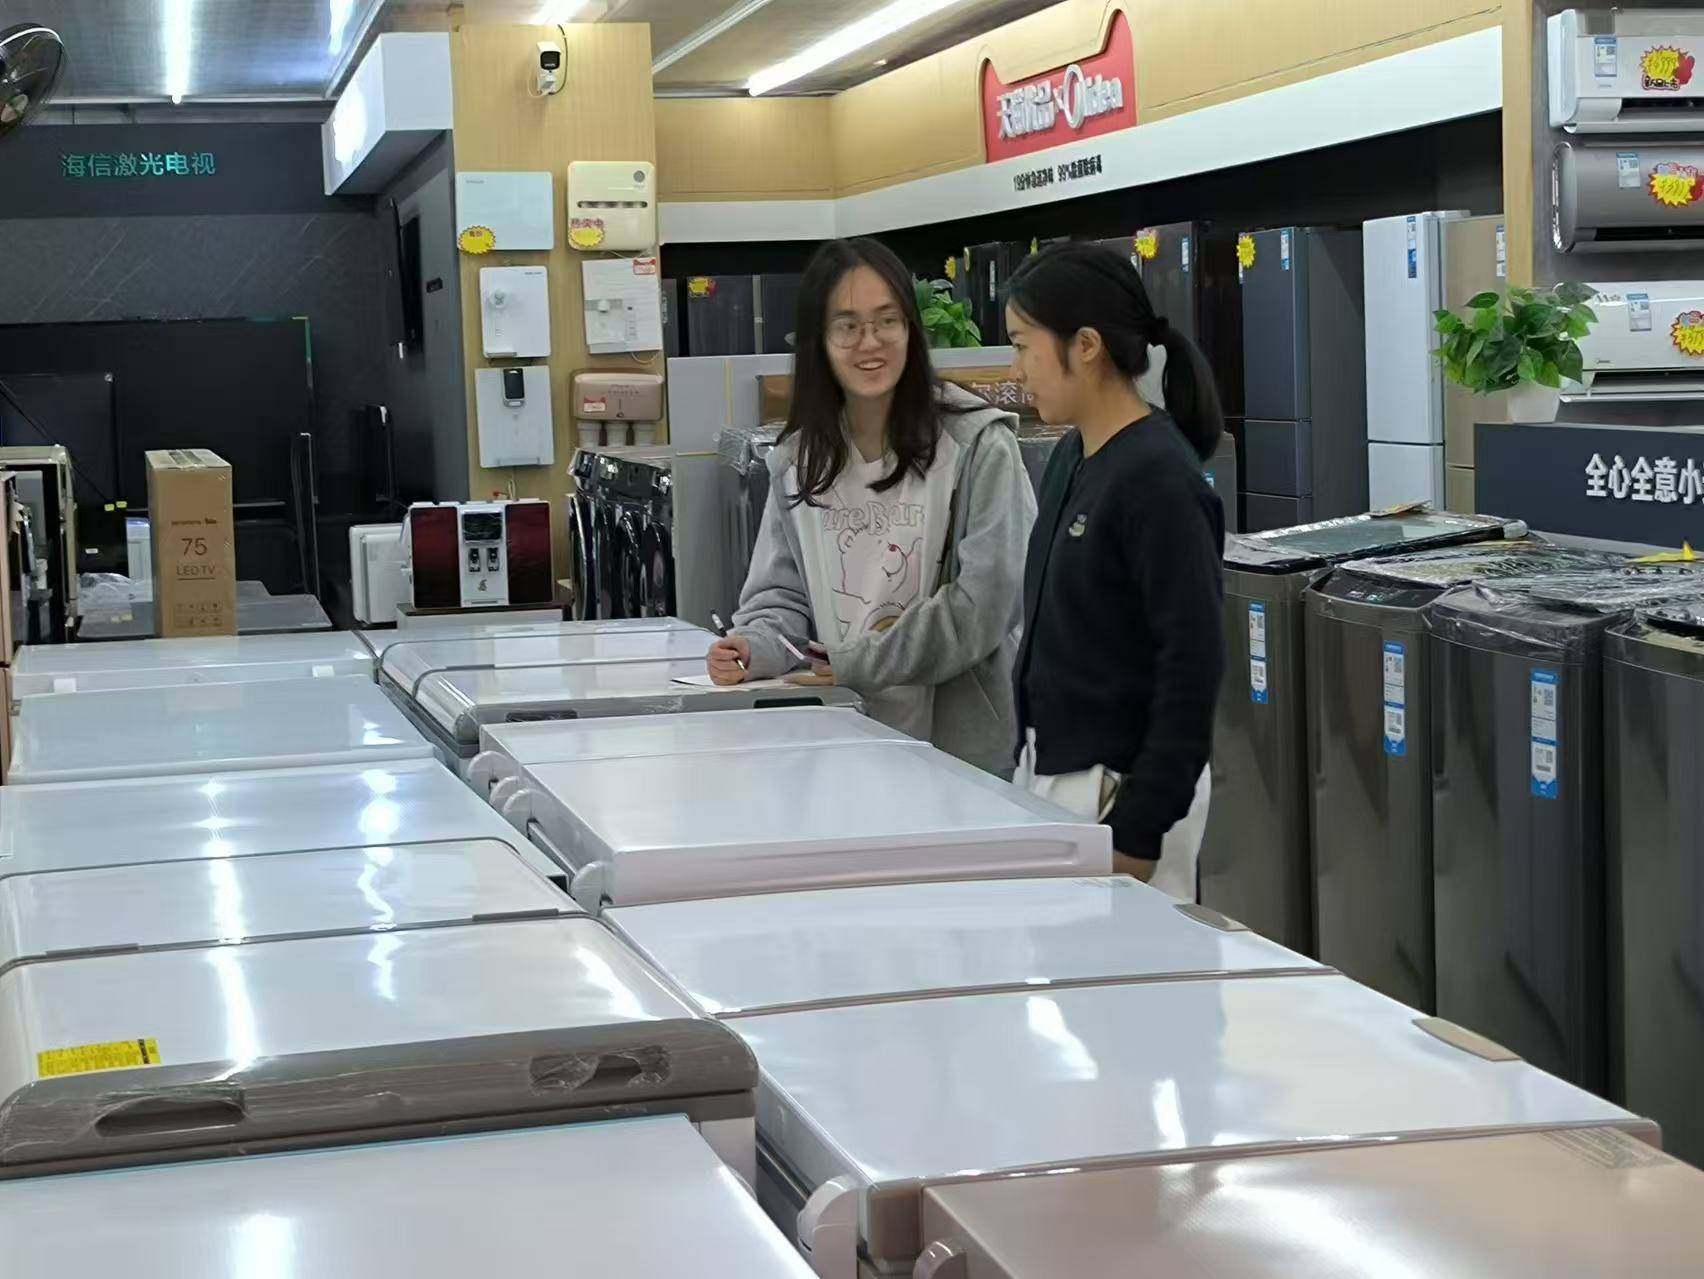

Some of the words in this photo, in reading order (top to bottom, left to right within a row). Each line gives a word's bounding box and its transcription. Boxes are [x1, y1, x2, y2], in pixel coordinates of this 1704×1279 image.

[61, 151, 216, 177] 海信激光电视
[1585, 452, 1704, 505] 全心全意小
[181, 537, 208, 556] 75
[176, 564, 200, 577] LED
[202, 564, 216, 576] TV
